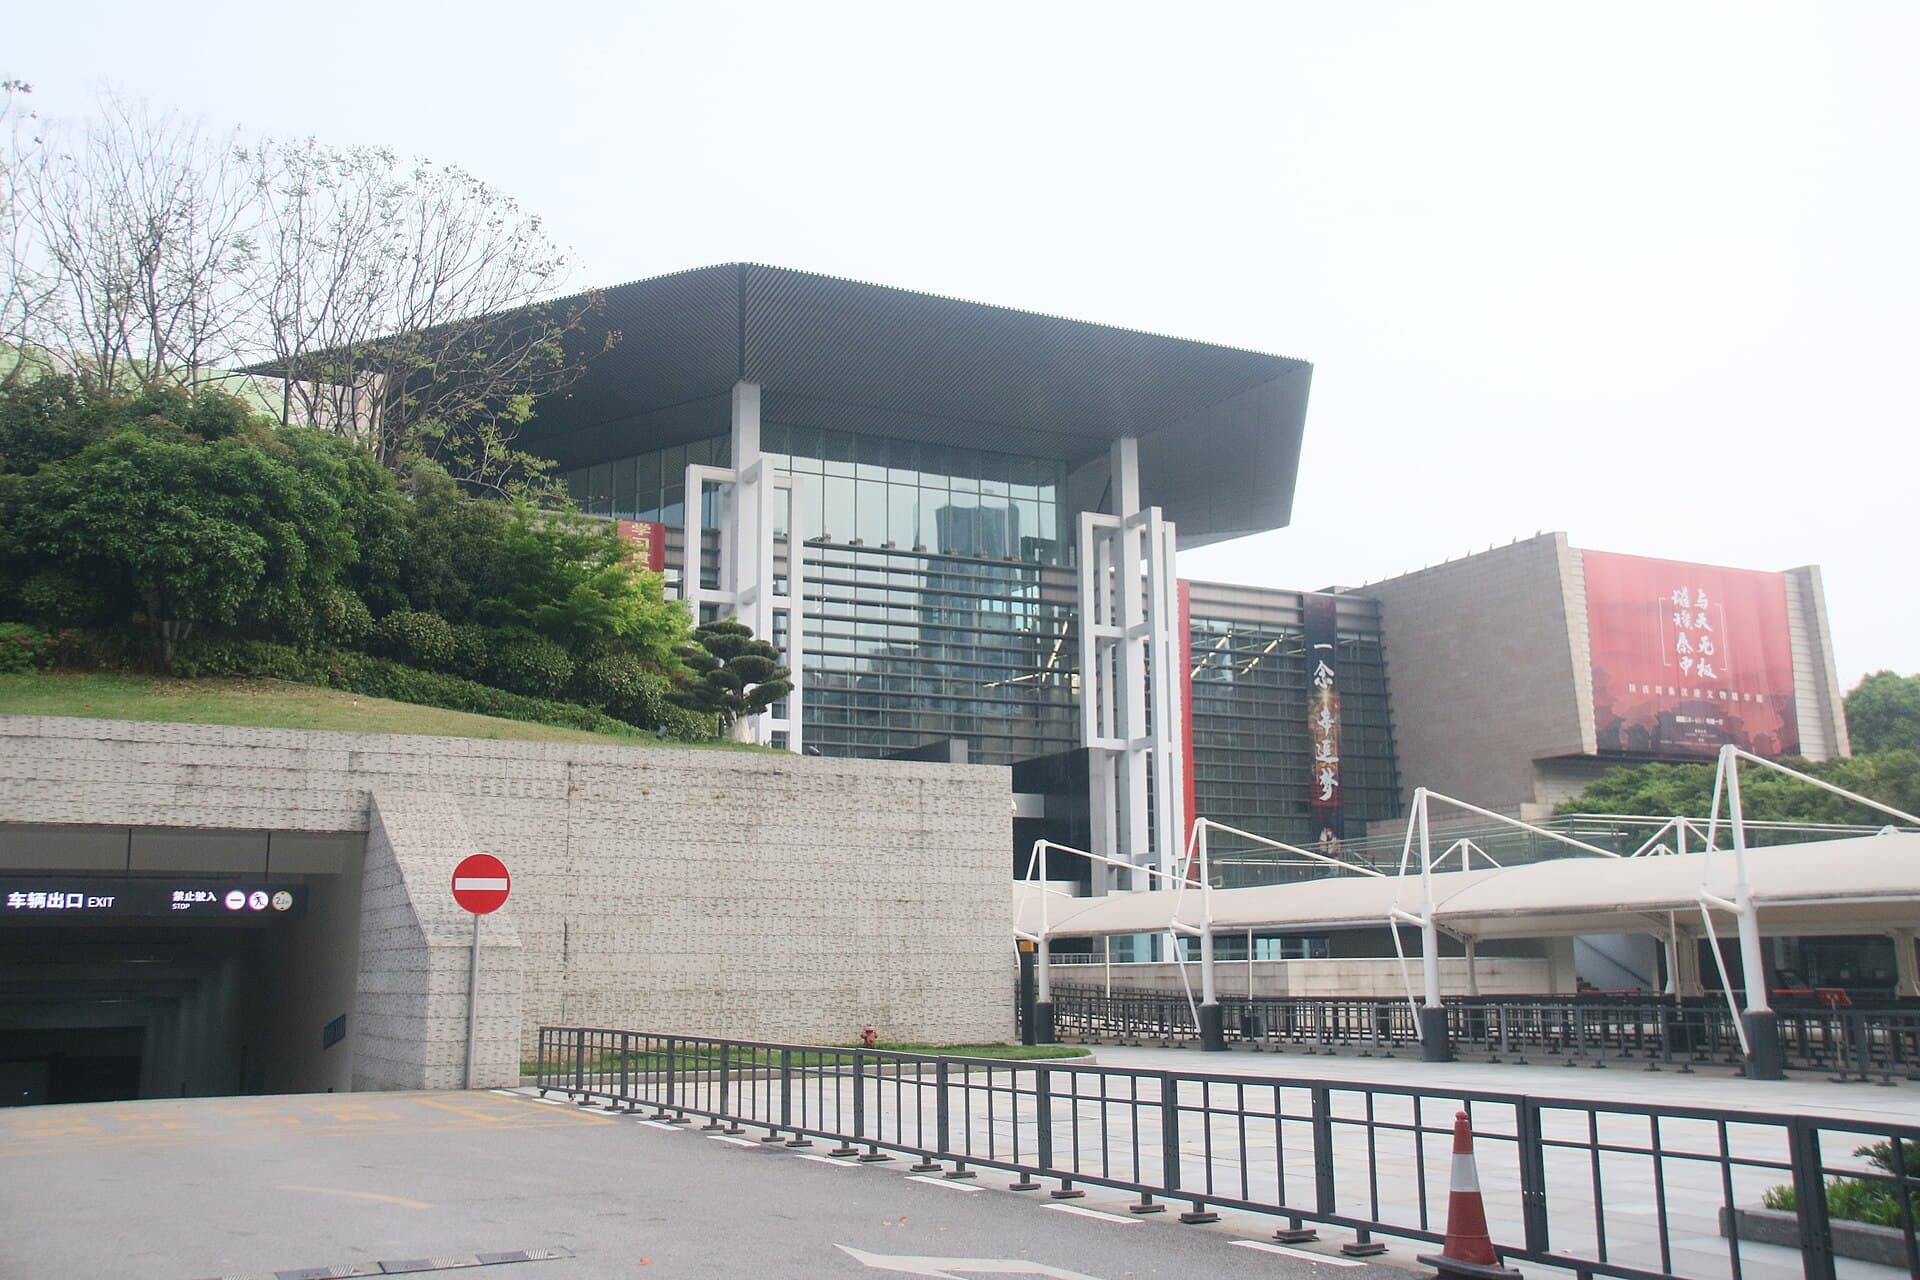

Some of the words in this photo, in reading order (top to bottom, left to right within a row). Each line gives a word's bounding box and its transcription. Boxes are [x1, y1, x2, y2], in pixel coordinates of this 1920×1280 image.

[7, 892, 84, 909] 车辆出口
[87, 897, 115, 908] EXIT
[172, 890, 217, 902] 禁止驶入
[172, 902, 191, 910] STOP
